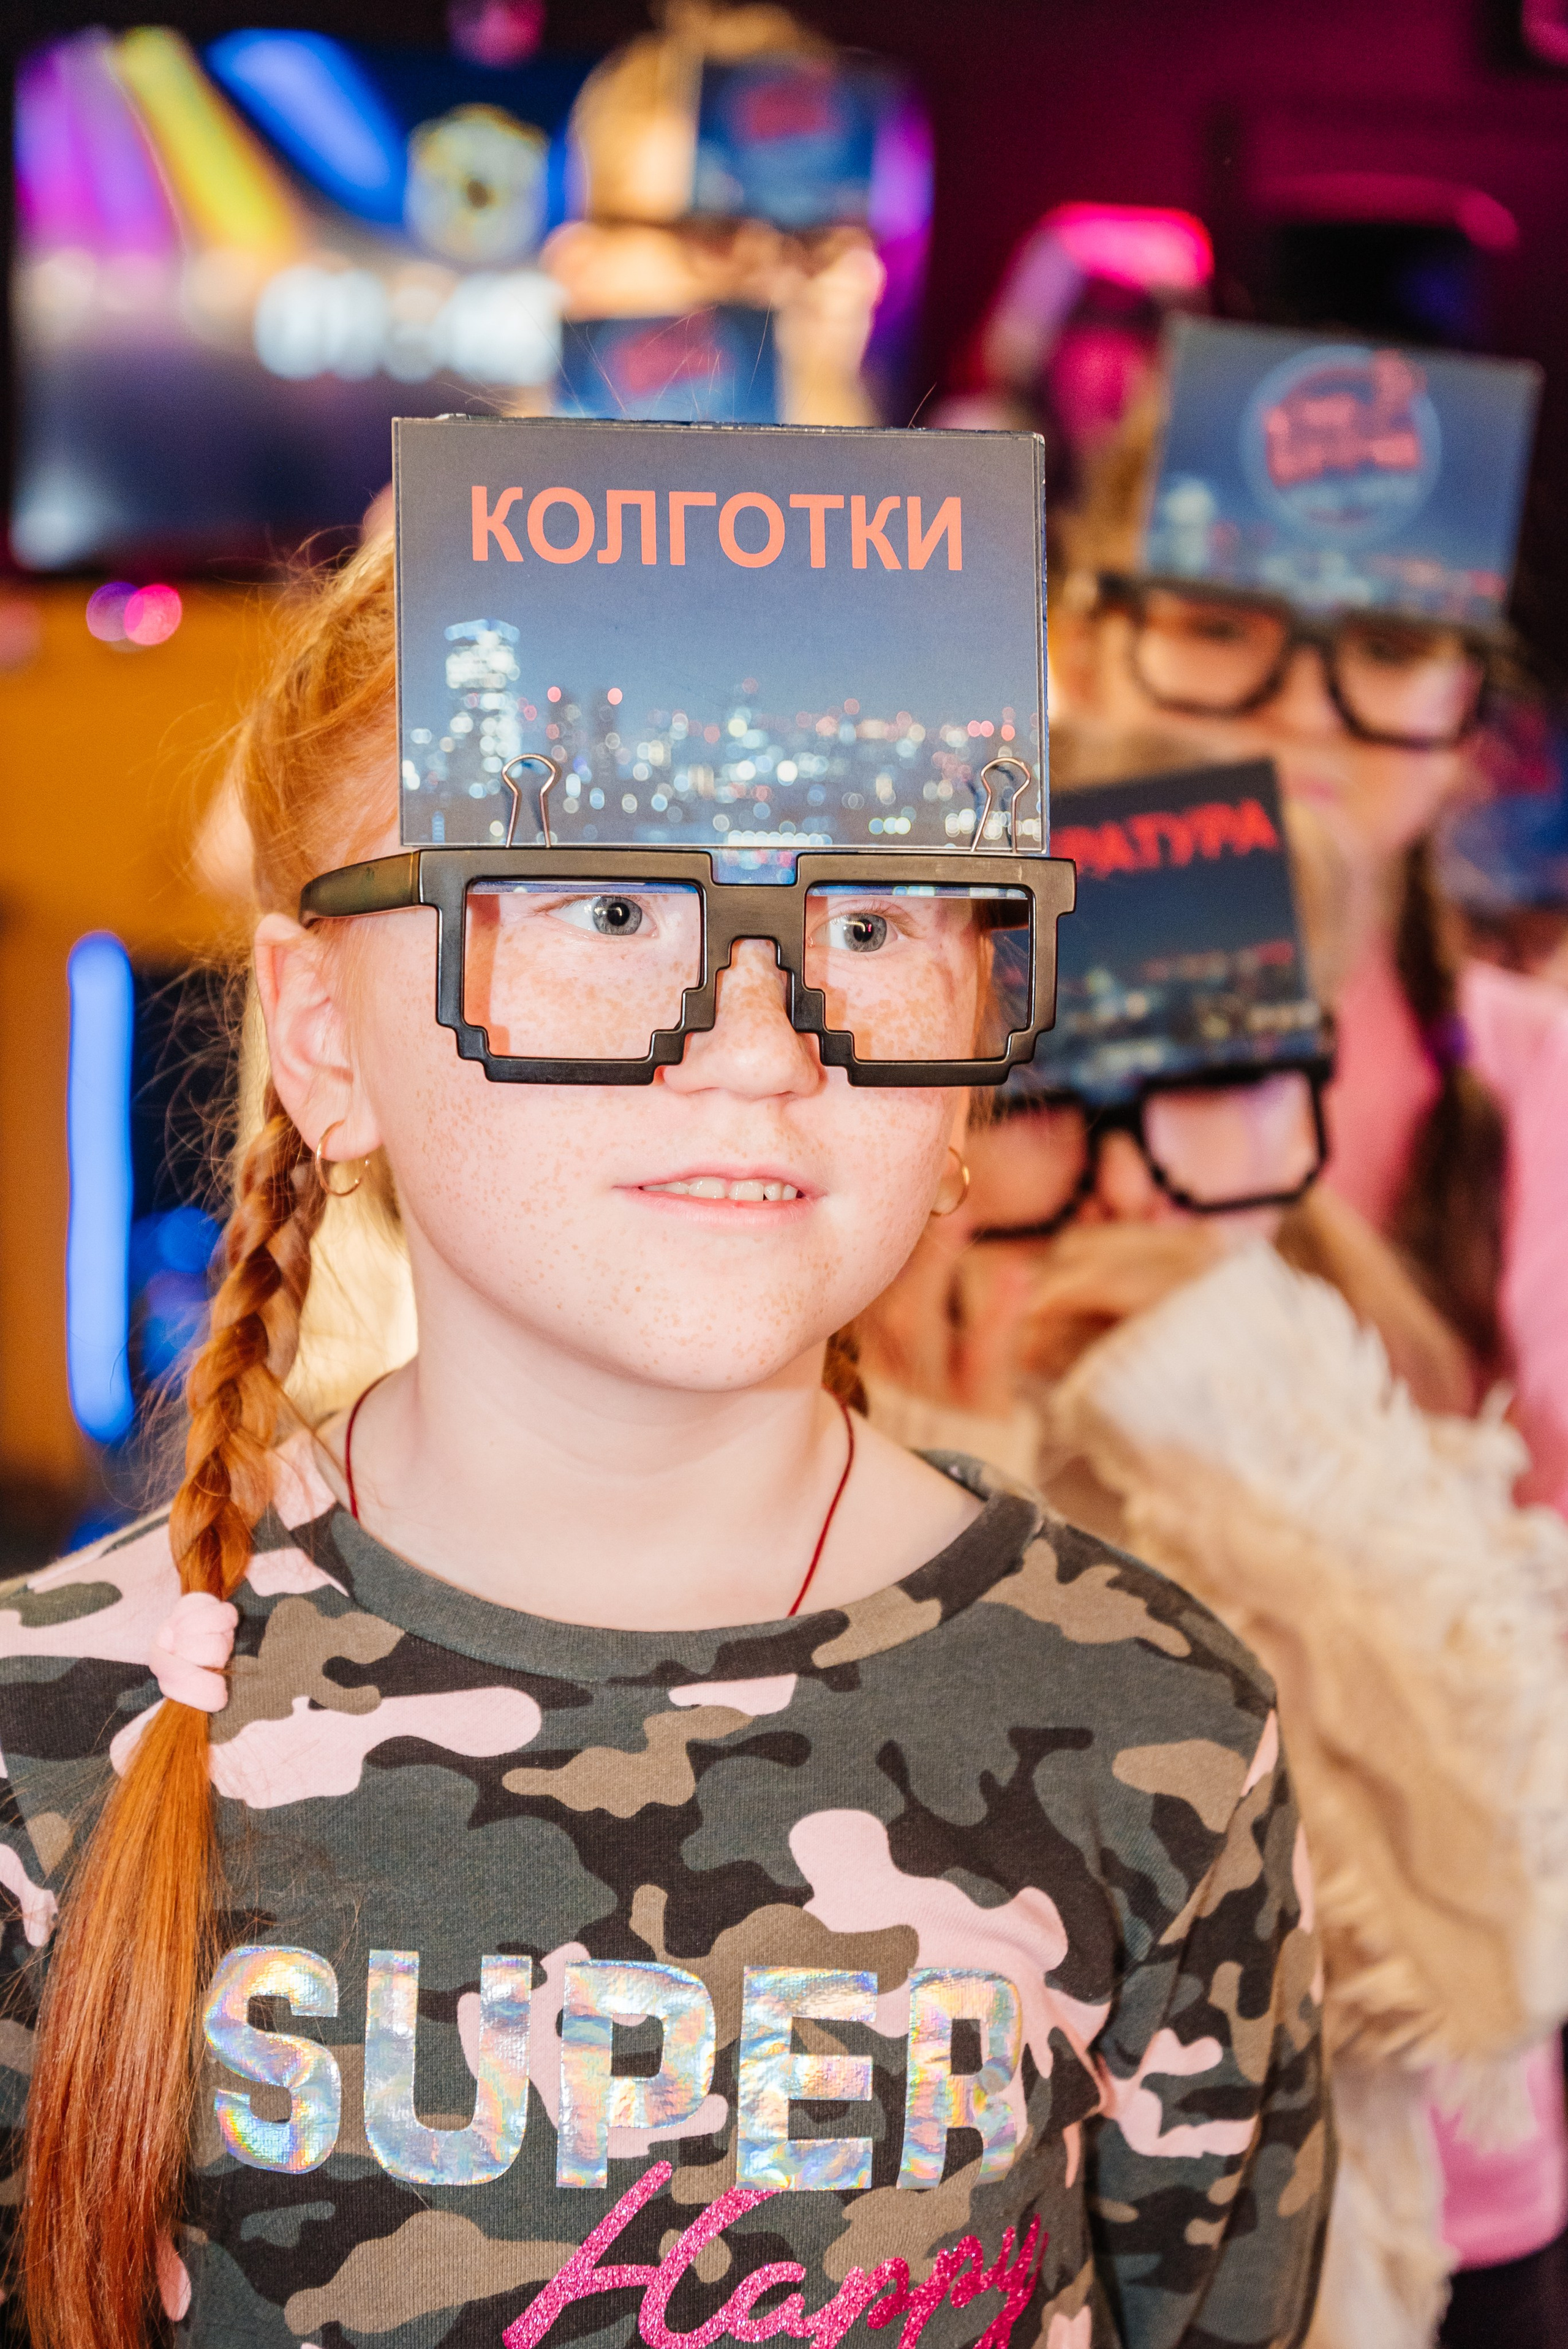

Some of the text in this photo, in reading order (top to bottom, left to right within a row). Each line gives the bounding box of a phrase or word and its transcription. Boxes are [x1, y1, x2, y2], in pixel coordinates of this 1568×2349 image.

[472, 485, 963, 570] КОЛГОТКИ
[1049, 796, 1279, 880] РАТУРА
[202, 1944, 1024, 2189] SUPER
[502, 2160, 1049, 2348] Happy
